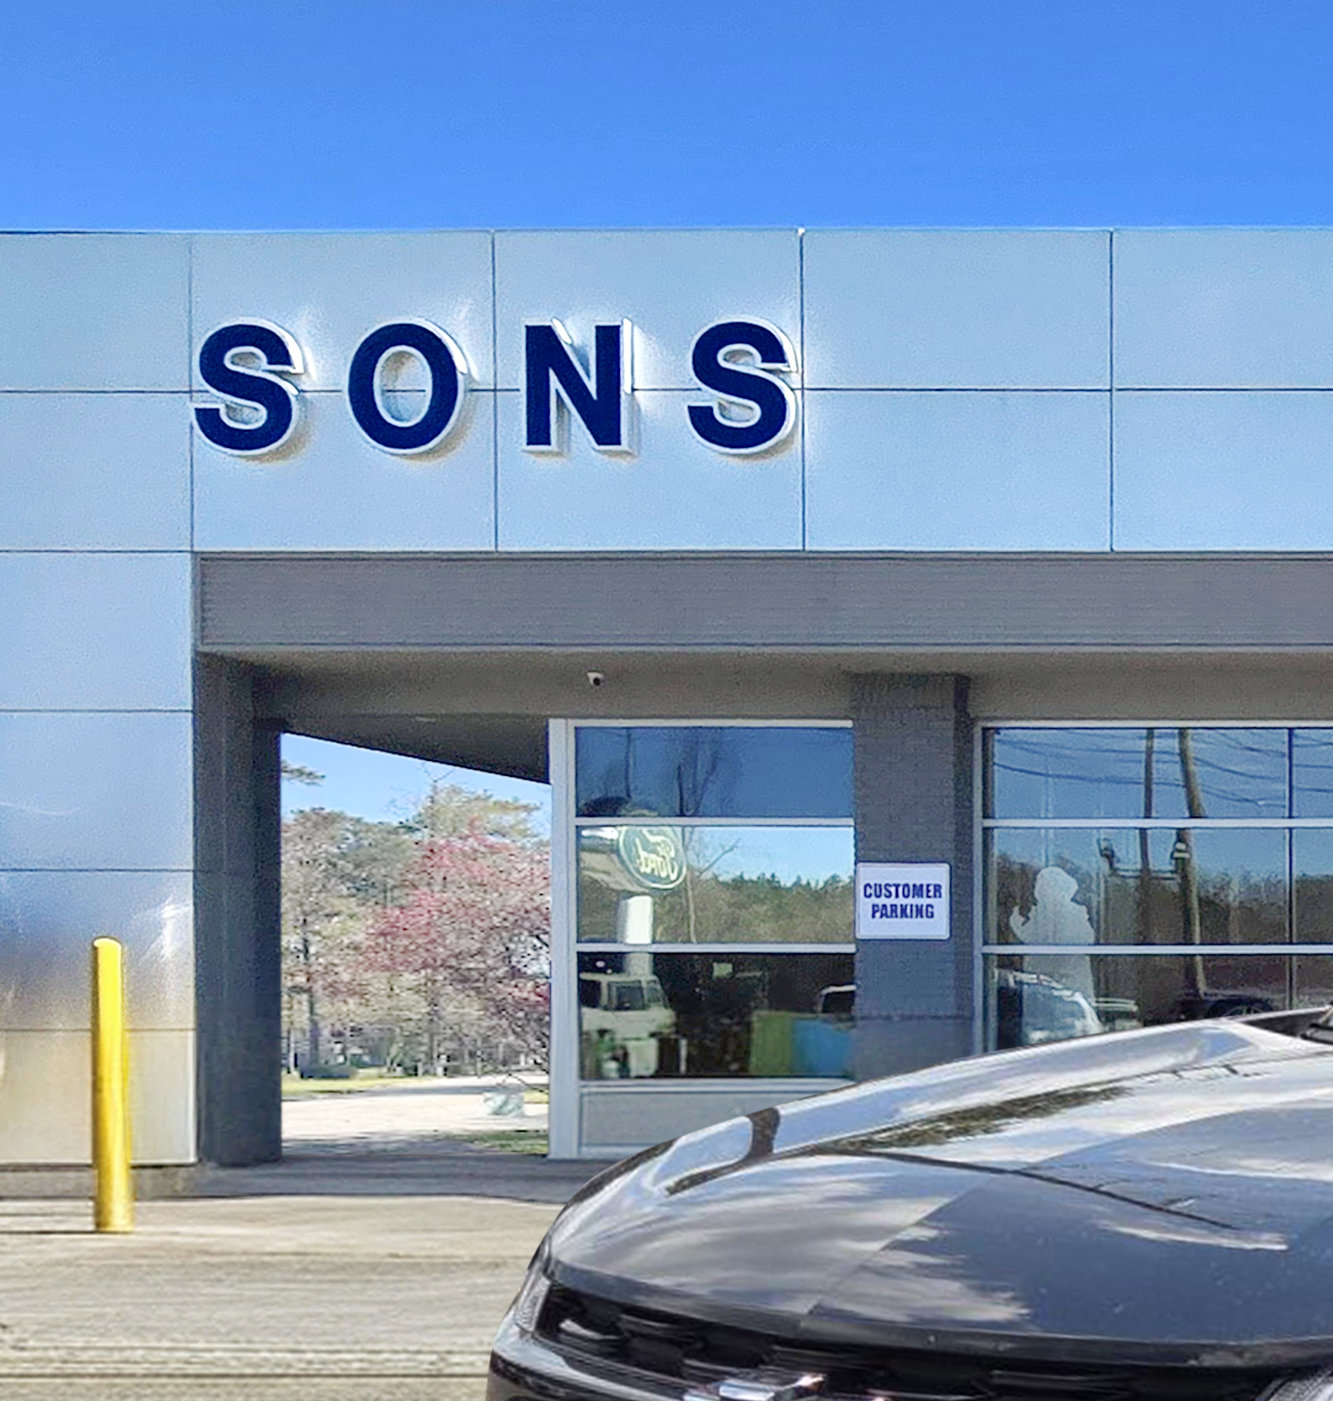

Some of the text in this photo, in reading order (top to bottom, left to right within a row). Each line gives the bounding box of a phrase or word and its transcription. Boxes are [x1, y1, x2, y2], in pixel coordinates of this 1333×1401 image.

[193, 319, 798, 454] SONS
[863, 881, 943, 900] CUSTOMER
[870, 902, 935, 920] PARKING
